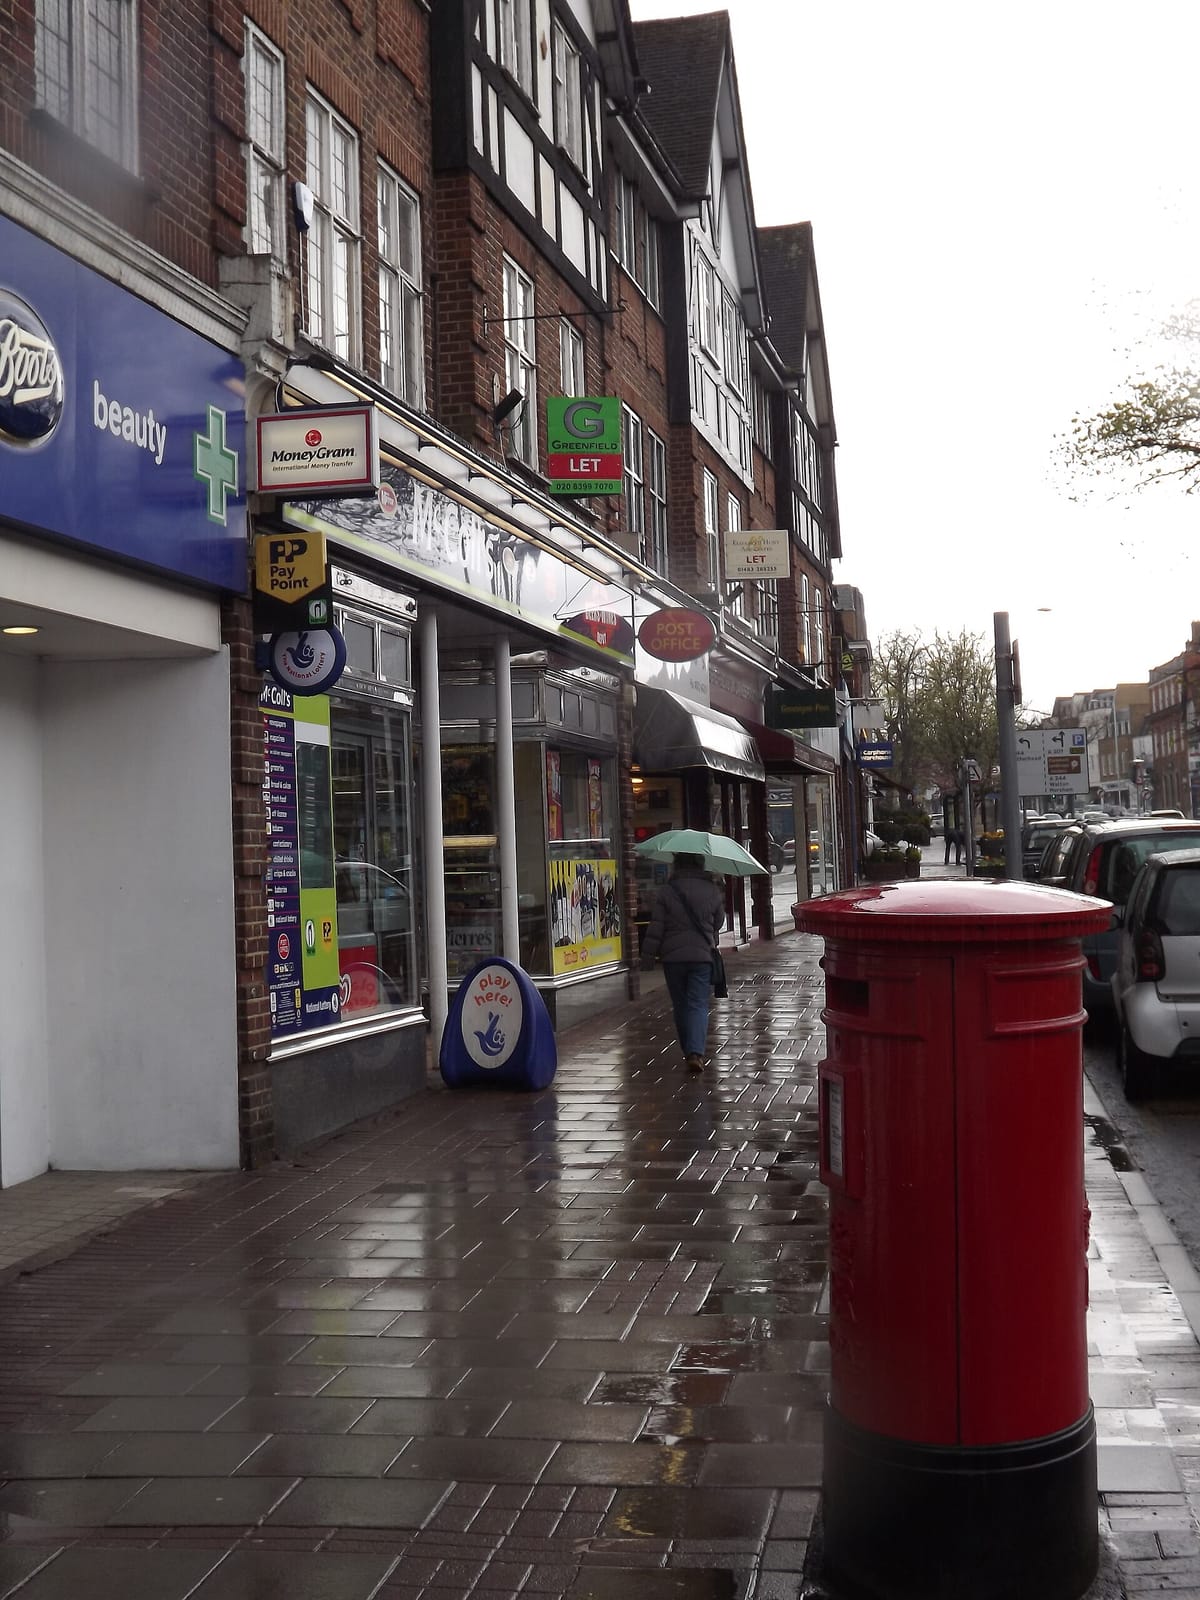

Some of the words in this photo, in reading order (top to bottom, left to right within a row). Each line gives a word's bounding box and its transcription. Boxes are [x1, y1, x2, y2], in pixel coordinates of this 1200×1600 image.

[93, 379, 167, 465] beauty
[563, 400, 605, 440] G
[551, 440, 618, 450] GREENFIELD
[271, 446, 355, 463] MoneyGram
[272, 464, 310, 472] International
[310, 462, 331, 470] Money
[569, 458, 602, 472] LET
[746, 555, 767, 564] LET
[270, 565, 296, 579] Pay
[270, 576, 309, 590] Point
[656, 623, 694, 635] POST
[651, 637, 701, 650] OFFICE
[287, 664, 312, 680] National
[312, 652, 326, 676] Lottery
[1074, 735, 1083, 745] P
[447, 929, 493, 946] ierre's
[479, 973, 511, 991] play
[474, 991, 512, 1008] here!
